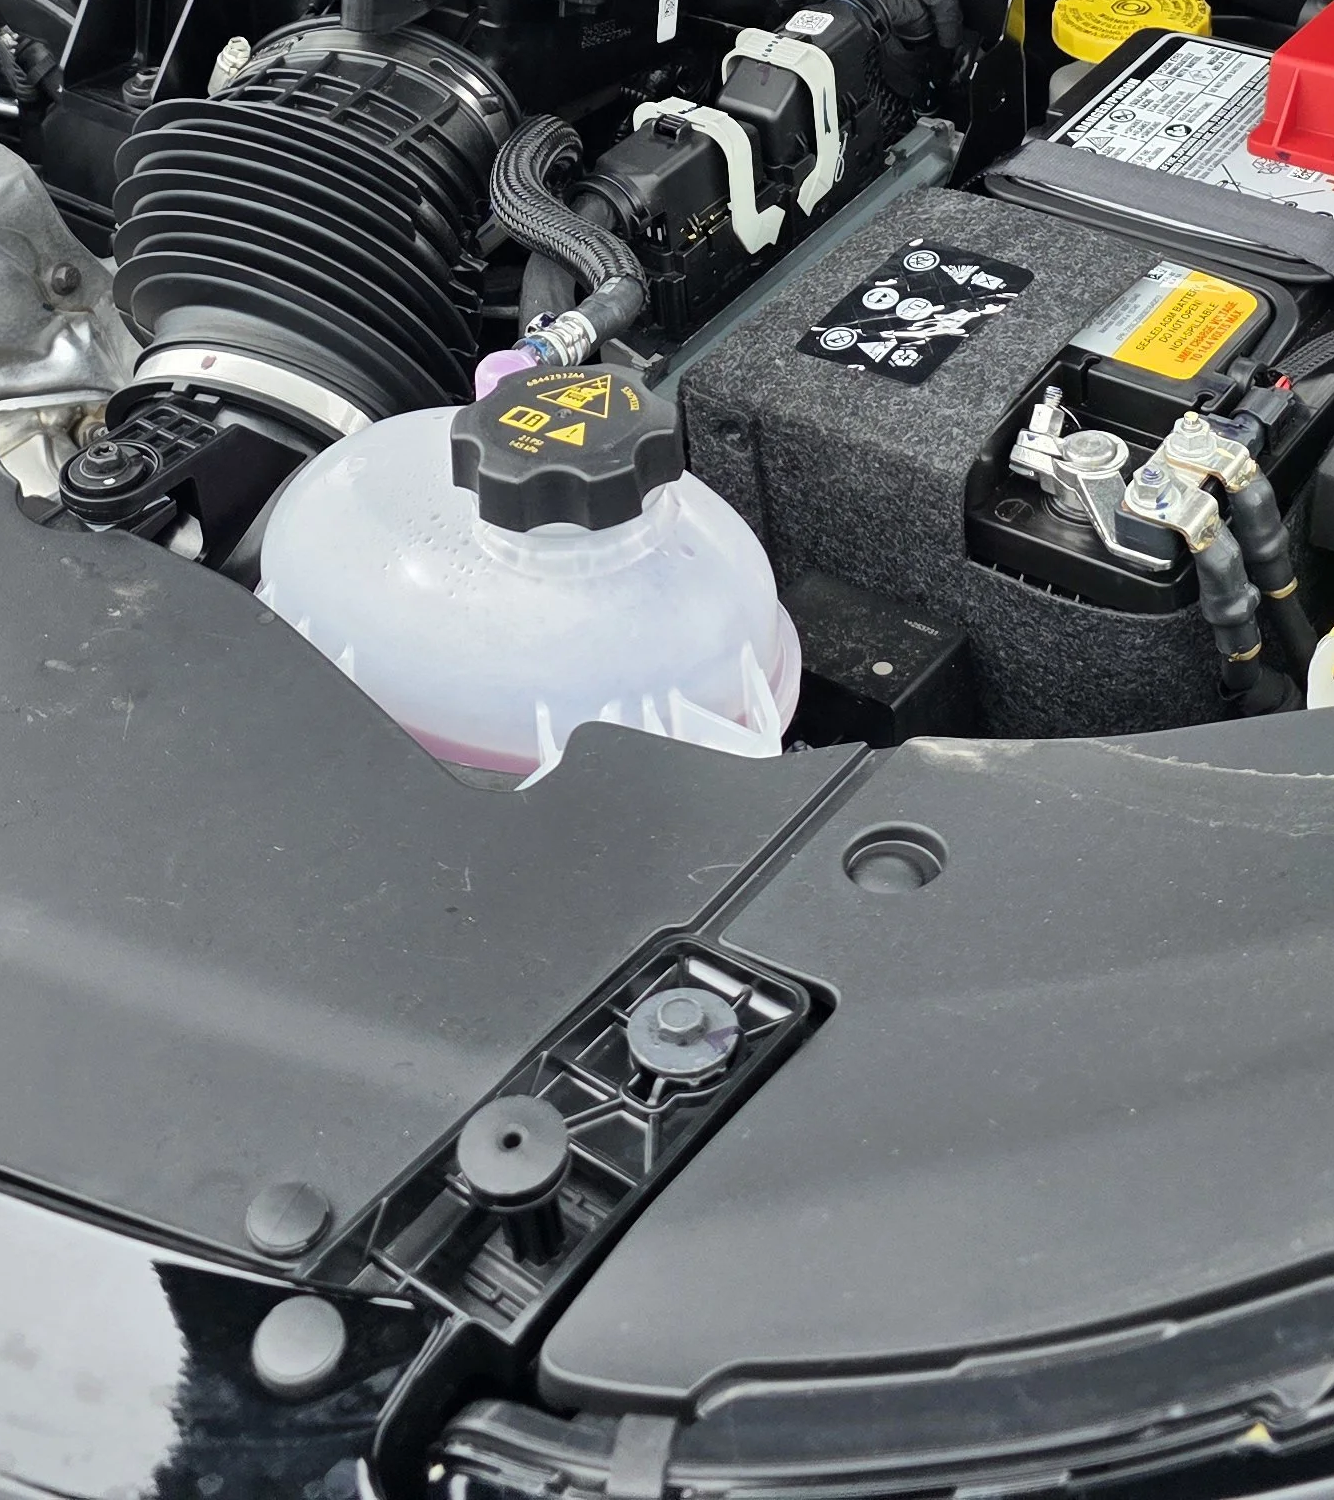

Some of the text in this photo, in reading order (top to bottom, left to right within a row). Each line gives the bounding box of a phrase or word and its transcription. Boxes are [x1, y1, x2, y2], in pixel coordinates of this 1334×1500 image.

[1167, 319, 1185, 332] NOT
[1168, 302, 1218, 352] NON-SPILLABLE
[1134, 326, 1163, 350] SEALED
[1190, 353, 1202, 361] TO
